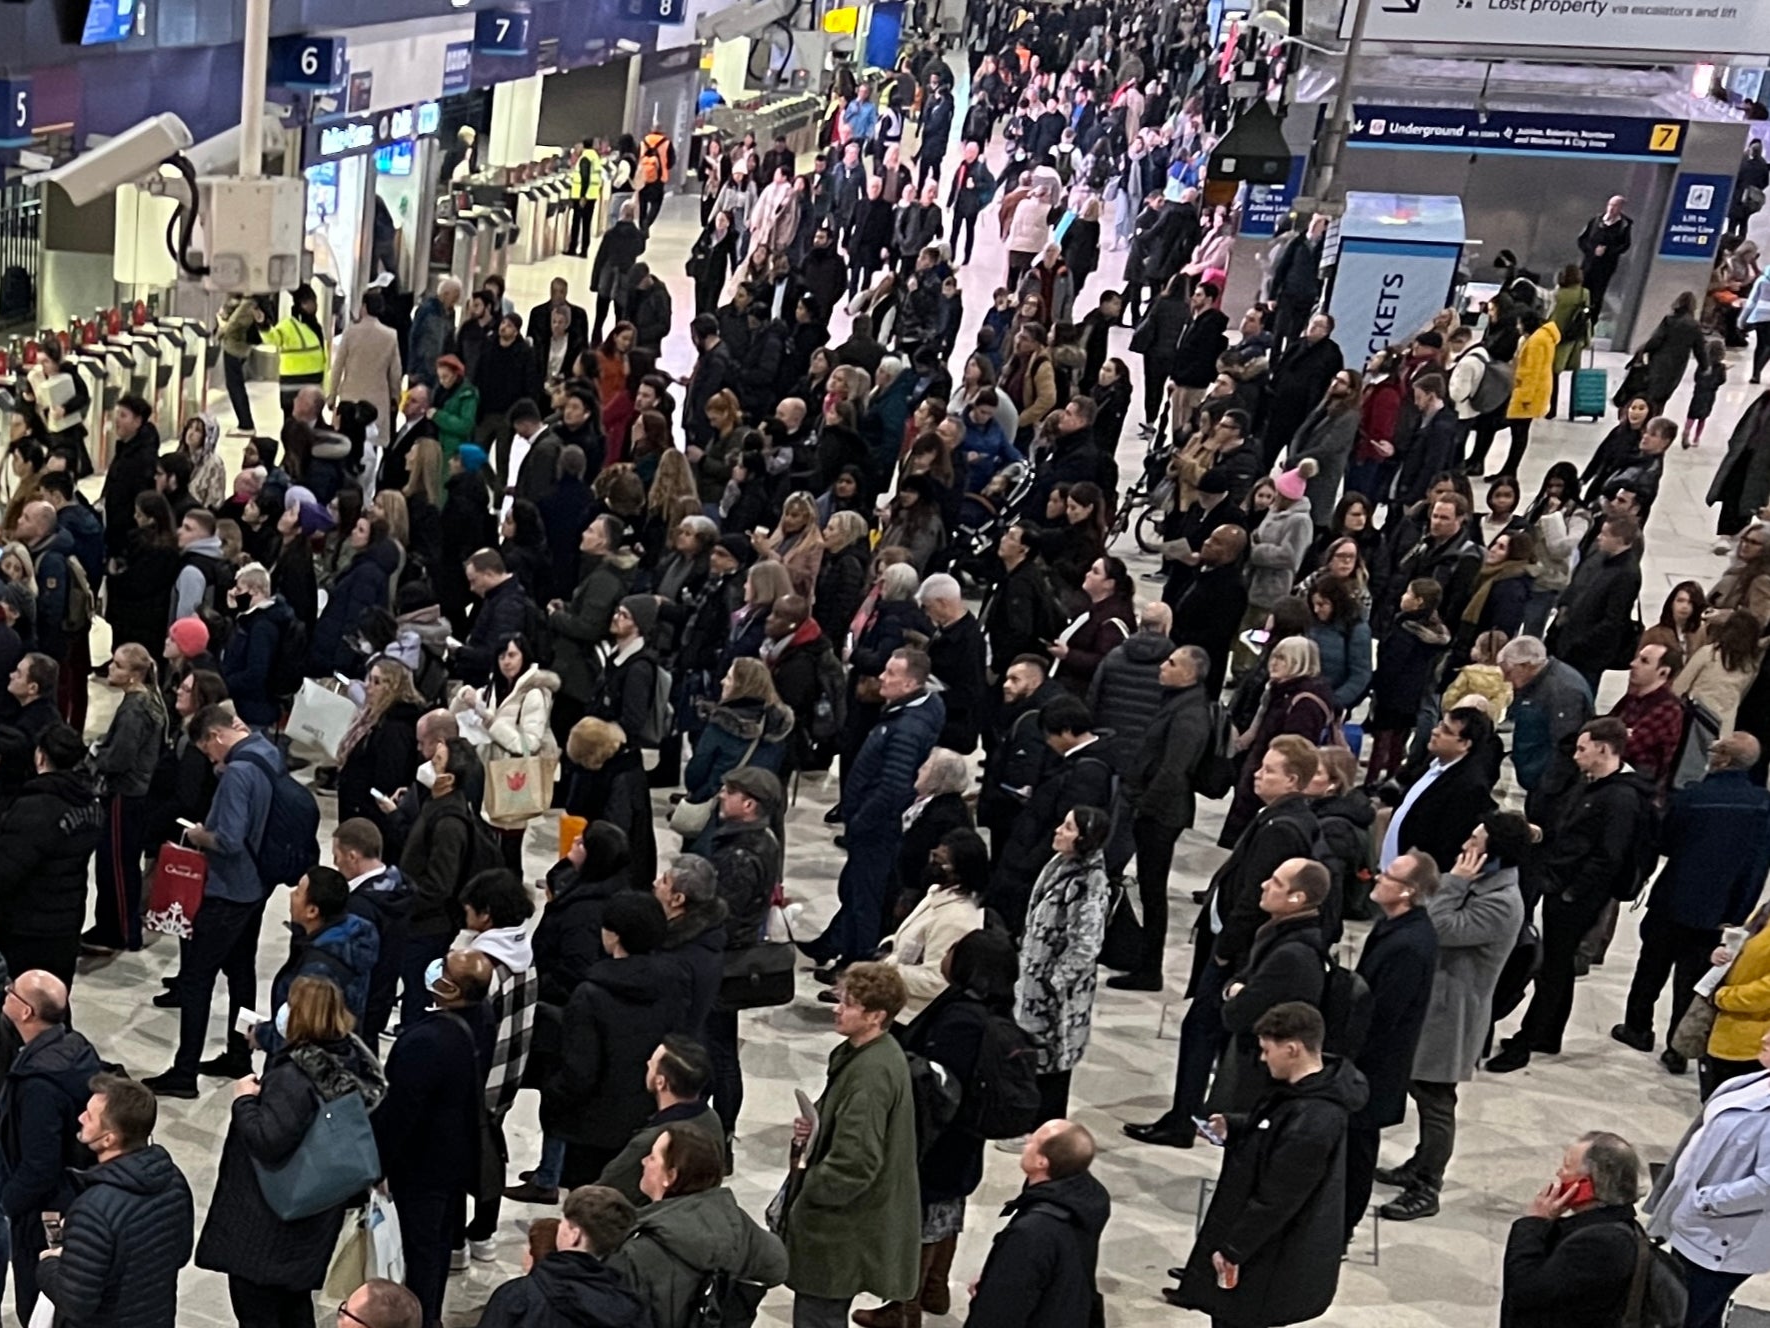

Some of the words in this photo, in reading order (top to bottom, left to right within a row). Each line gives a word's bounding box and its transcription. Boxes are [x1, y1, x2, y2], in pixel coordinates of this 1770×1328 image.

[1488, 0, 1527, 10] Lost
[1529, 0, 1608, 18] property
[1631, 5, 1693, 17] escalators
[1695, 8, 1718, 18] and
[1721, 8, 1737, 19] lift
[495, 19, 510, 43] 7
[301, 47, 318, 75] 6
[334, 48, 343, 75] 6
[16, 92, 27, 127] 5
[1389, 122, 1465, 138] Underground
[1659, 127, 1673, 147] 7
